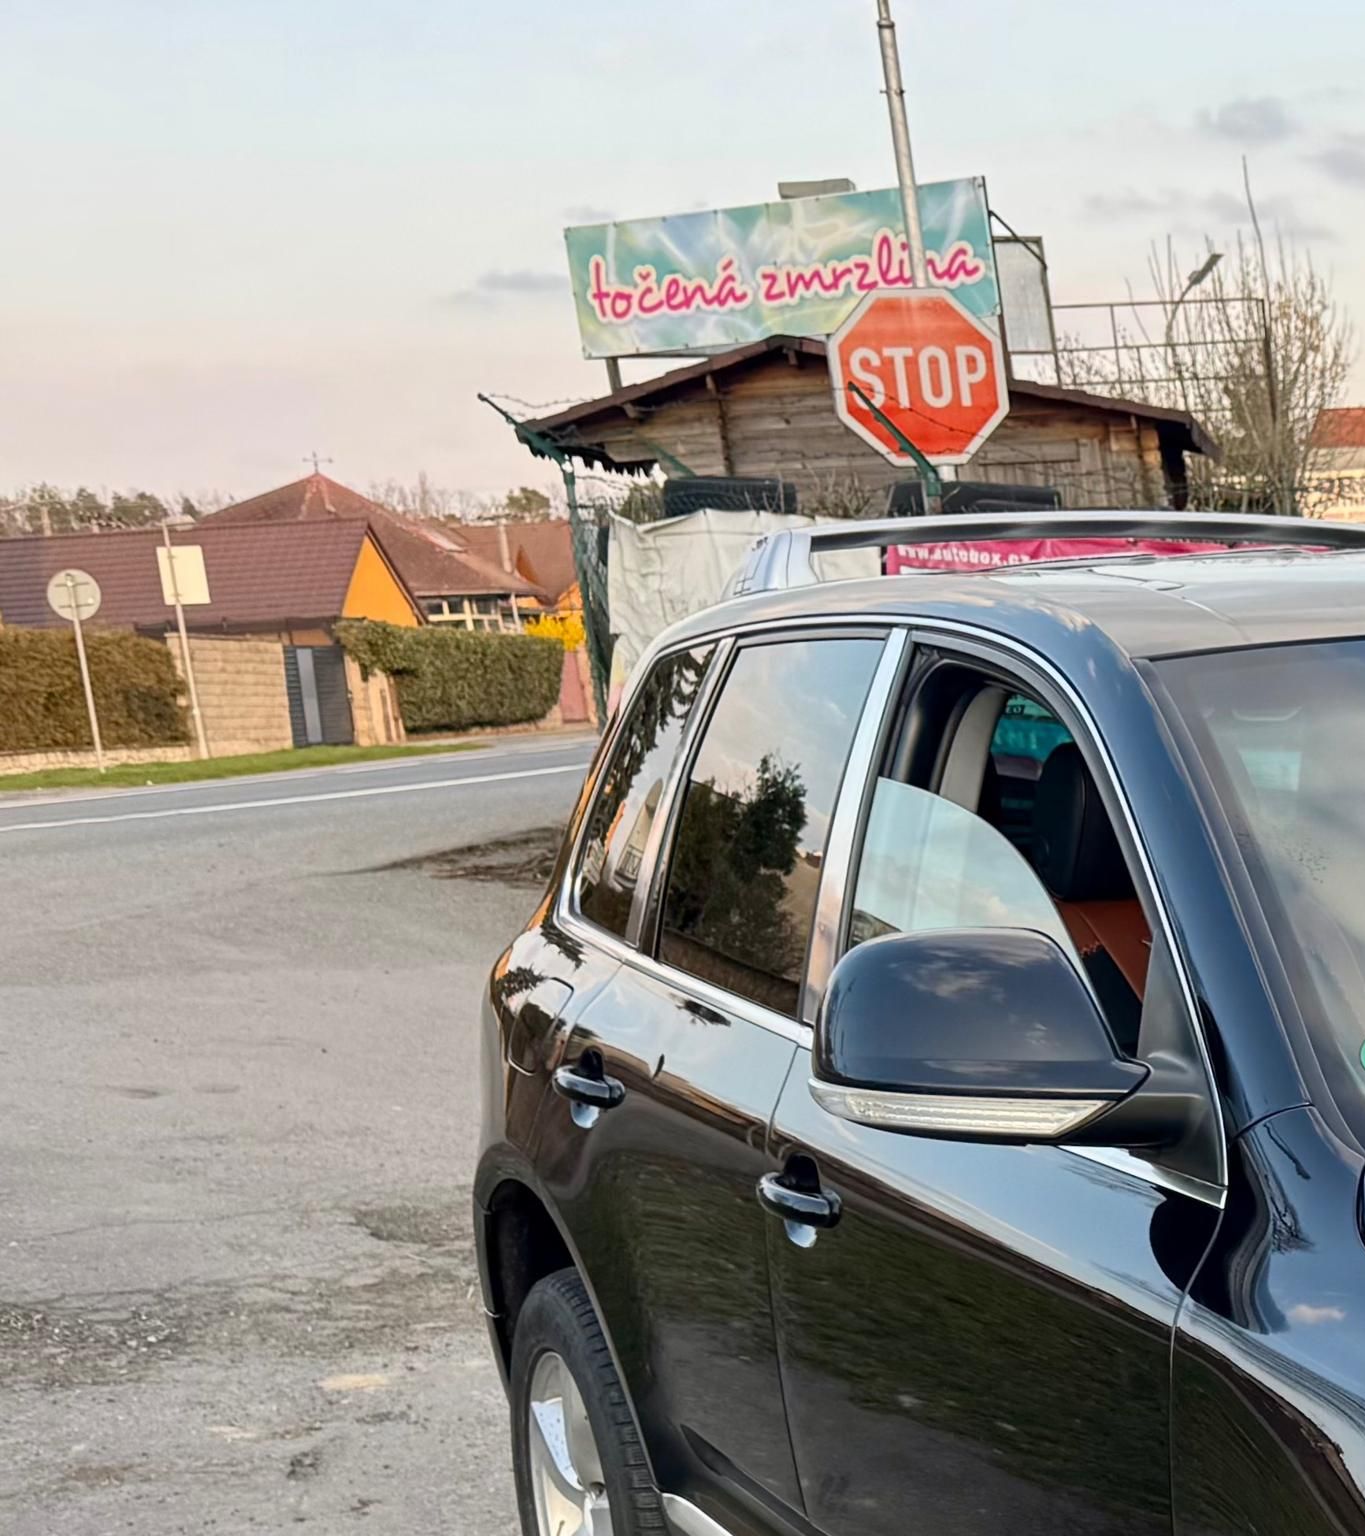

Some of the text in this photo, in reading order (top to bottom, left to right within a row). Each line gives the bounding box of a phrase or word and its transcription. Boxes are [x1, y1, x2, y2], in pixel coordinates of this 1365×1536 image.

[590, 232, 981, 319] točená zmrzlina
[848, 345, 988, 410] STOP
